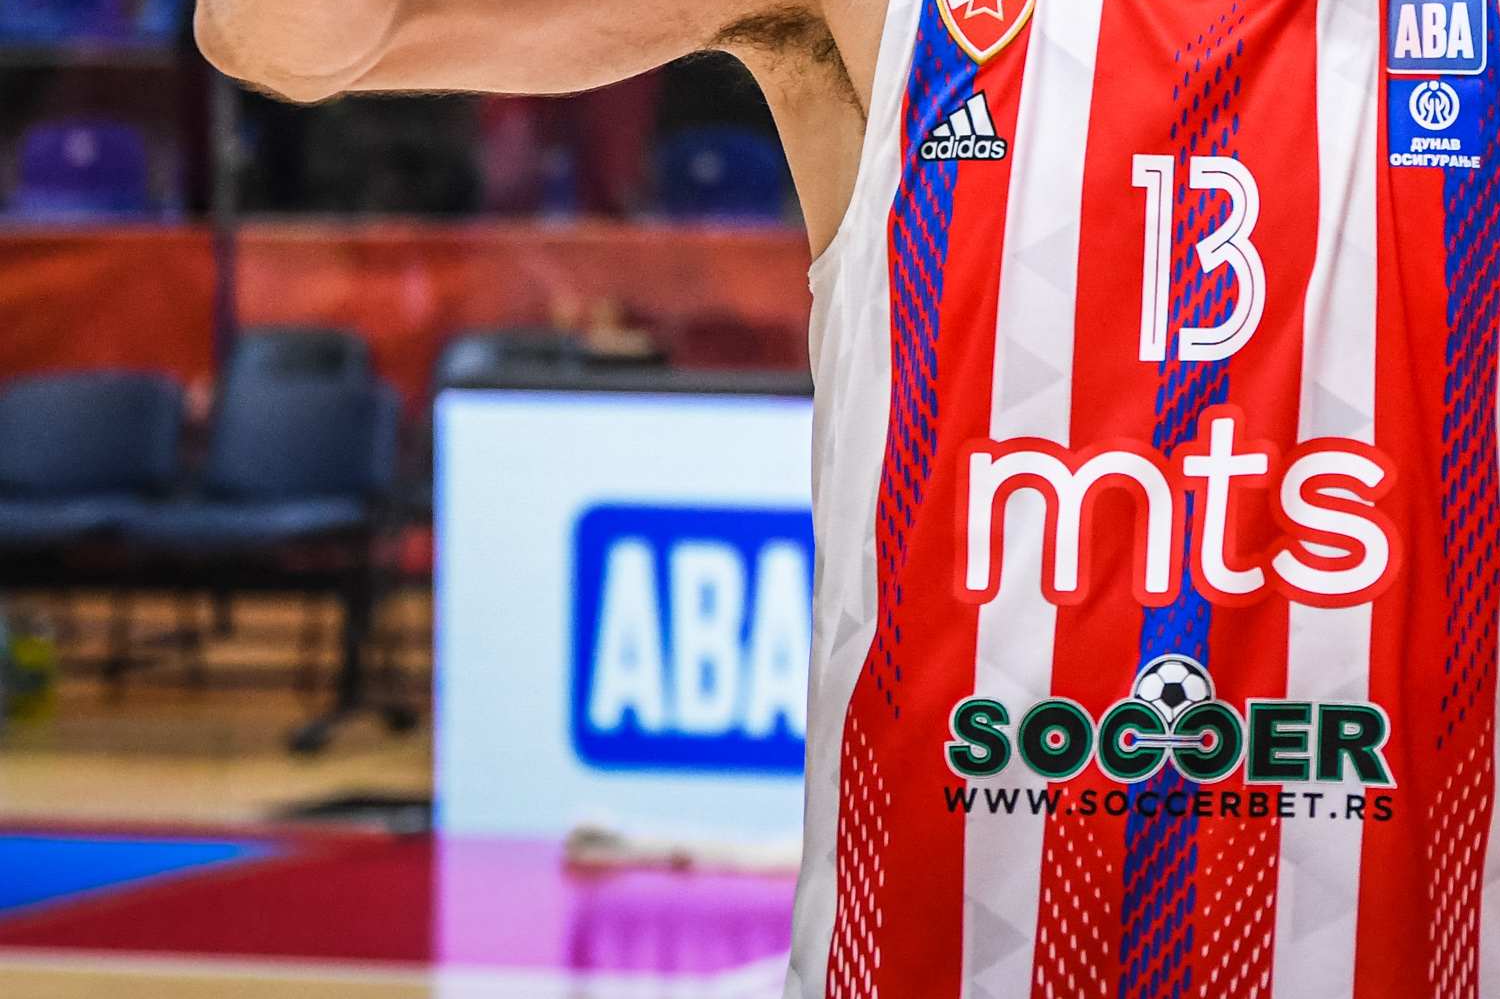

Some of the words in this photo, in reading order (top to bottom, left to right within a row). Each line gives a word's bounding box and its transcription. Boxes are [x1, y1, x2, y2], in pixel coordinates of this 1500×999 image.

[1394, 2, 1475, 59] ABA
[920, 136, 1006, 160] adidas
[1389, 153, 1481, 169] ОСИГУРАЊЕ
[1410, 137, 1462, 153] ДУНАВ
[1131, 153, 1267, 362] 13
[963, 416, 1391, 597] mts
[589, 538, 811, 738] ABA
[945, 697, 1396, 787] SOCCER
[942, 785, 1395, 822] WWW.SOCCERBET.RS
